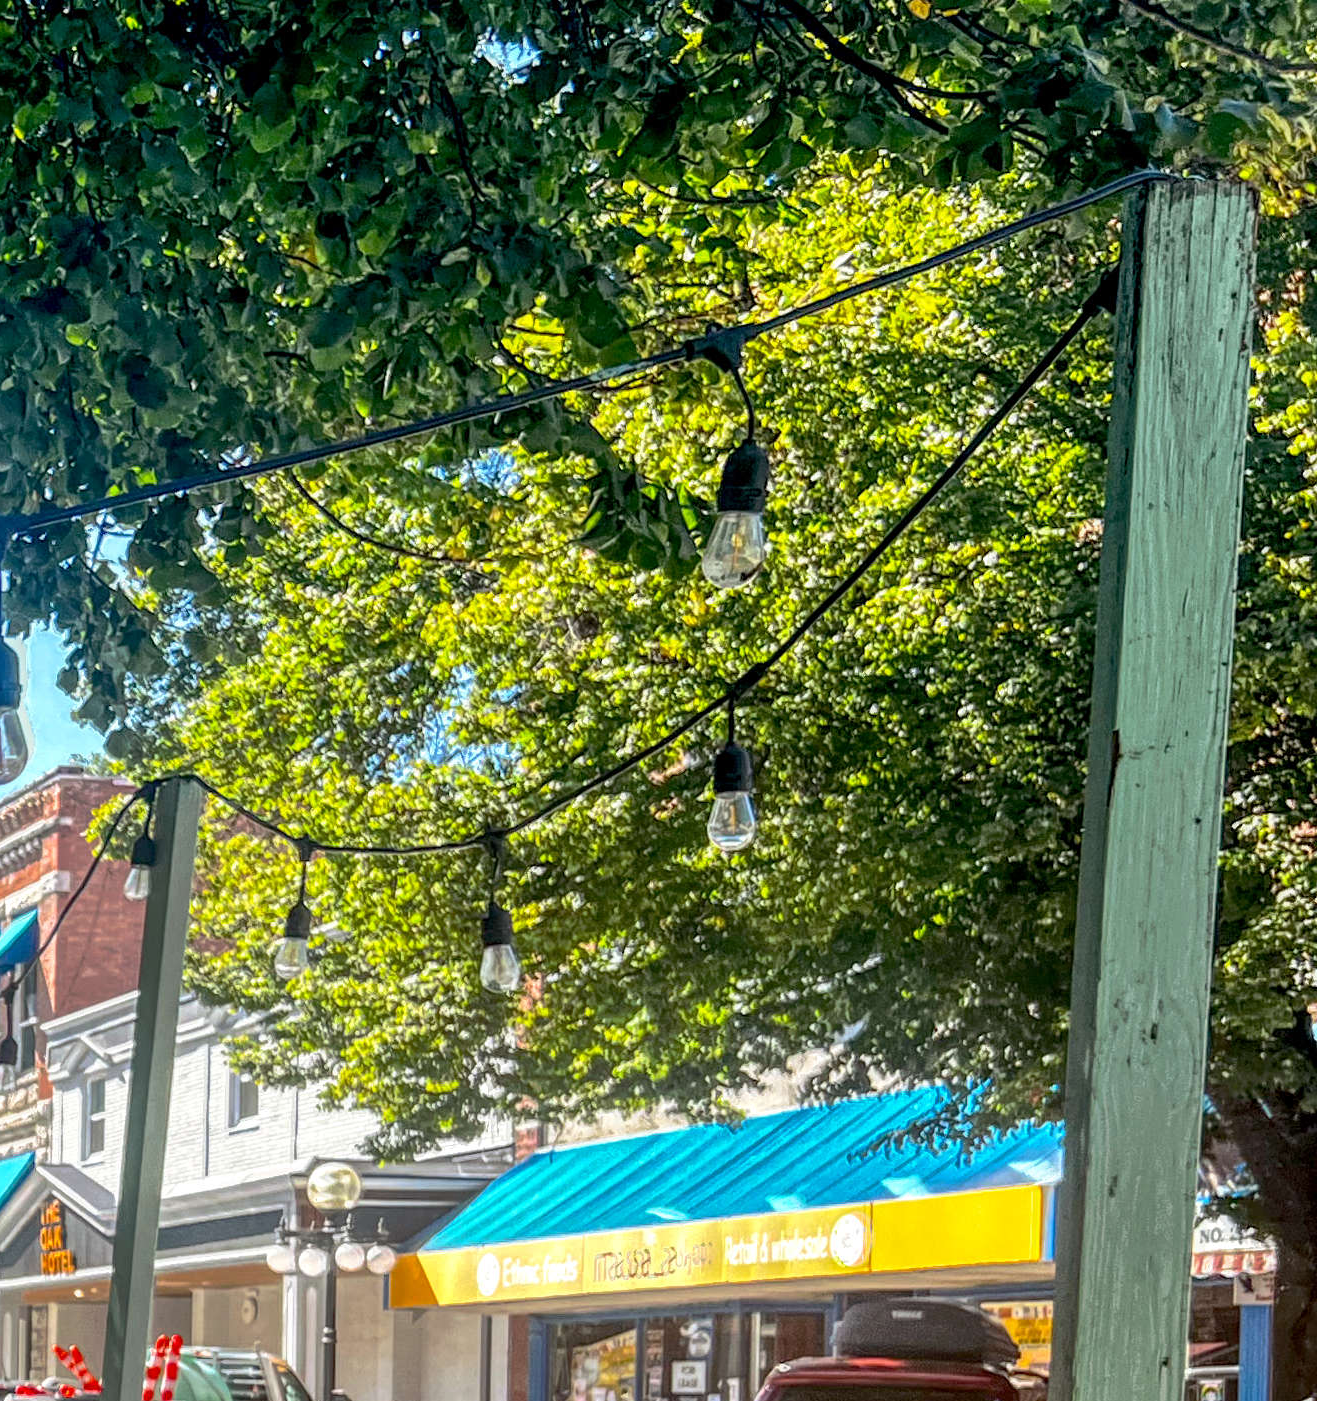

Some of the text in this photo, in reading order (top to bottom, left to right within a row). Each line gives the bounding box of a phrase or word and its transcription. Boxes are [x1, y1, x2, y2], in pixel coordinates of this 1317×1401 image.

[40, 1226, 63, 1251] OAK
[725, 1232, 759, 1265] Retail
[771, 1227, 828, 1262] wholesale
[40, 1249, 76, 1275] HOTEL
[502, 1256, 540, 1288] Ethnic
[542, 1253, 579, 1286] foods
